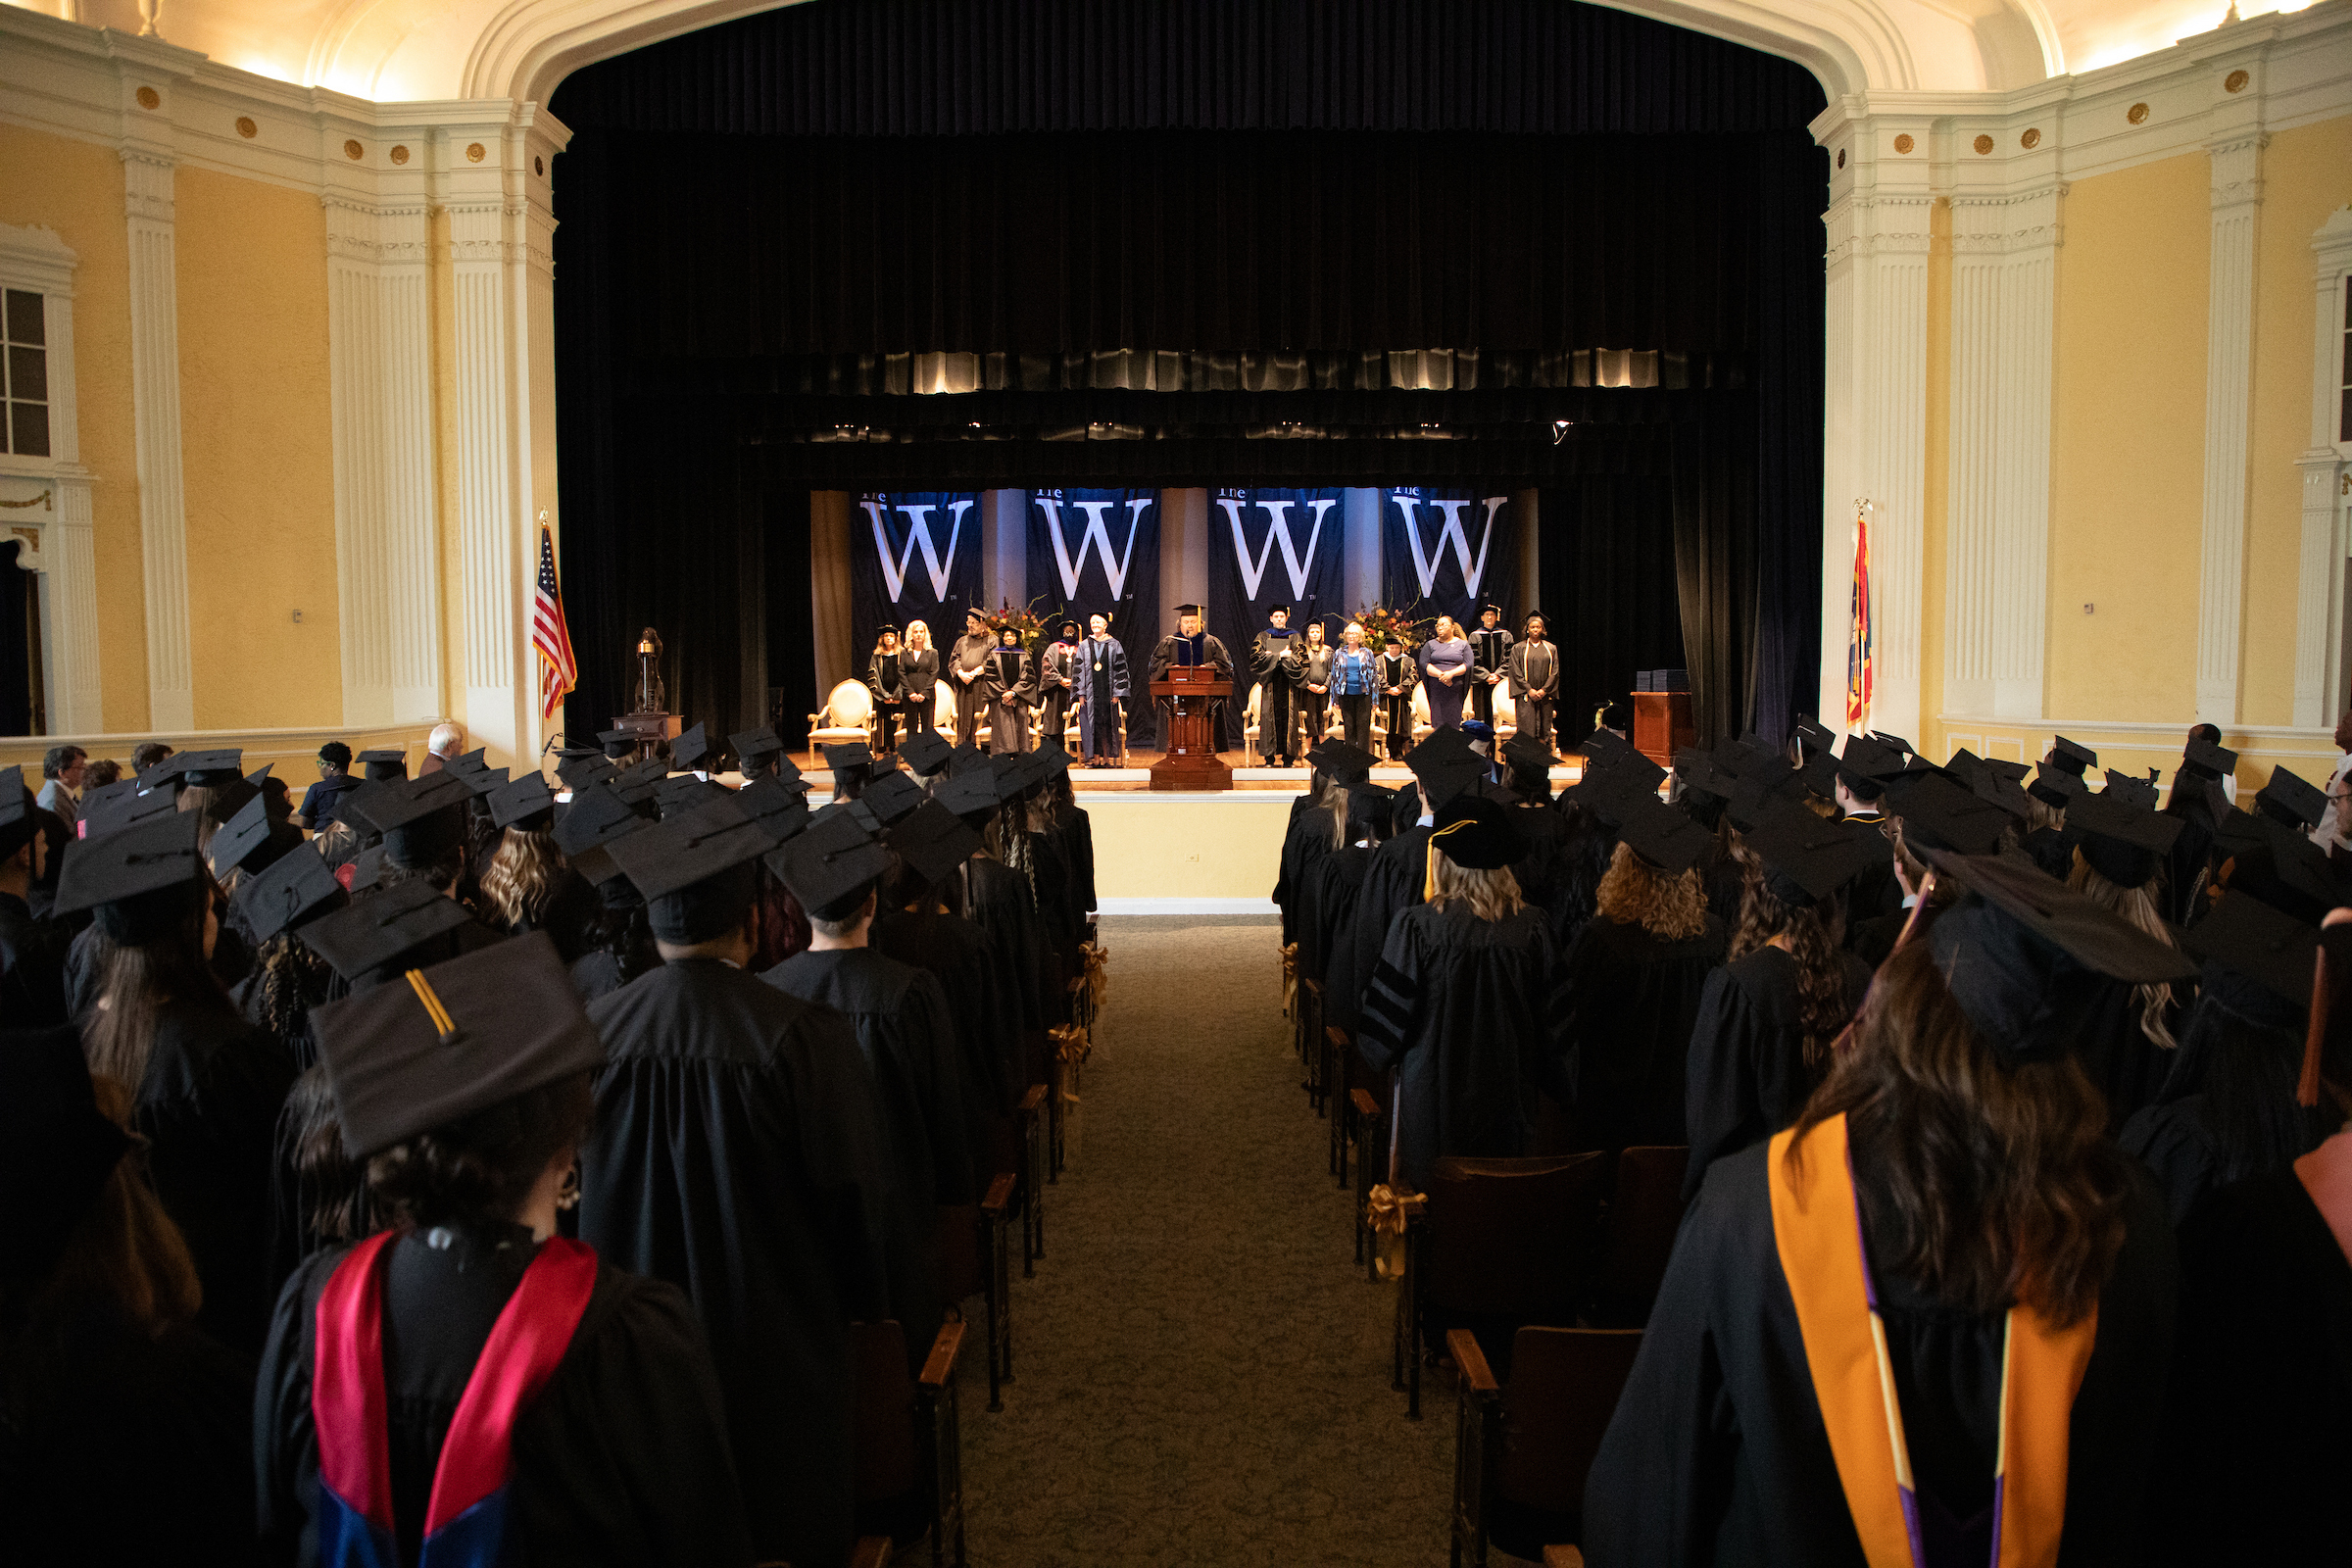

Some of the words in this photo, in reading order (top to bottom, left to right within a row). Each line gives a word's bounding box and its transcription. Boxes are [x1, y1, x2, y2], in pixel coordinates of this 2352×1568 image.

[859, 500, 974, 603] W
[1035, 498, 1152, 601] W
[1216, 499, 1337, 601] W
[1392, 496, 1508, 599] W
